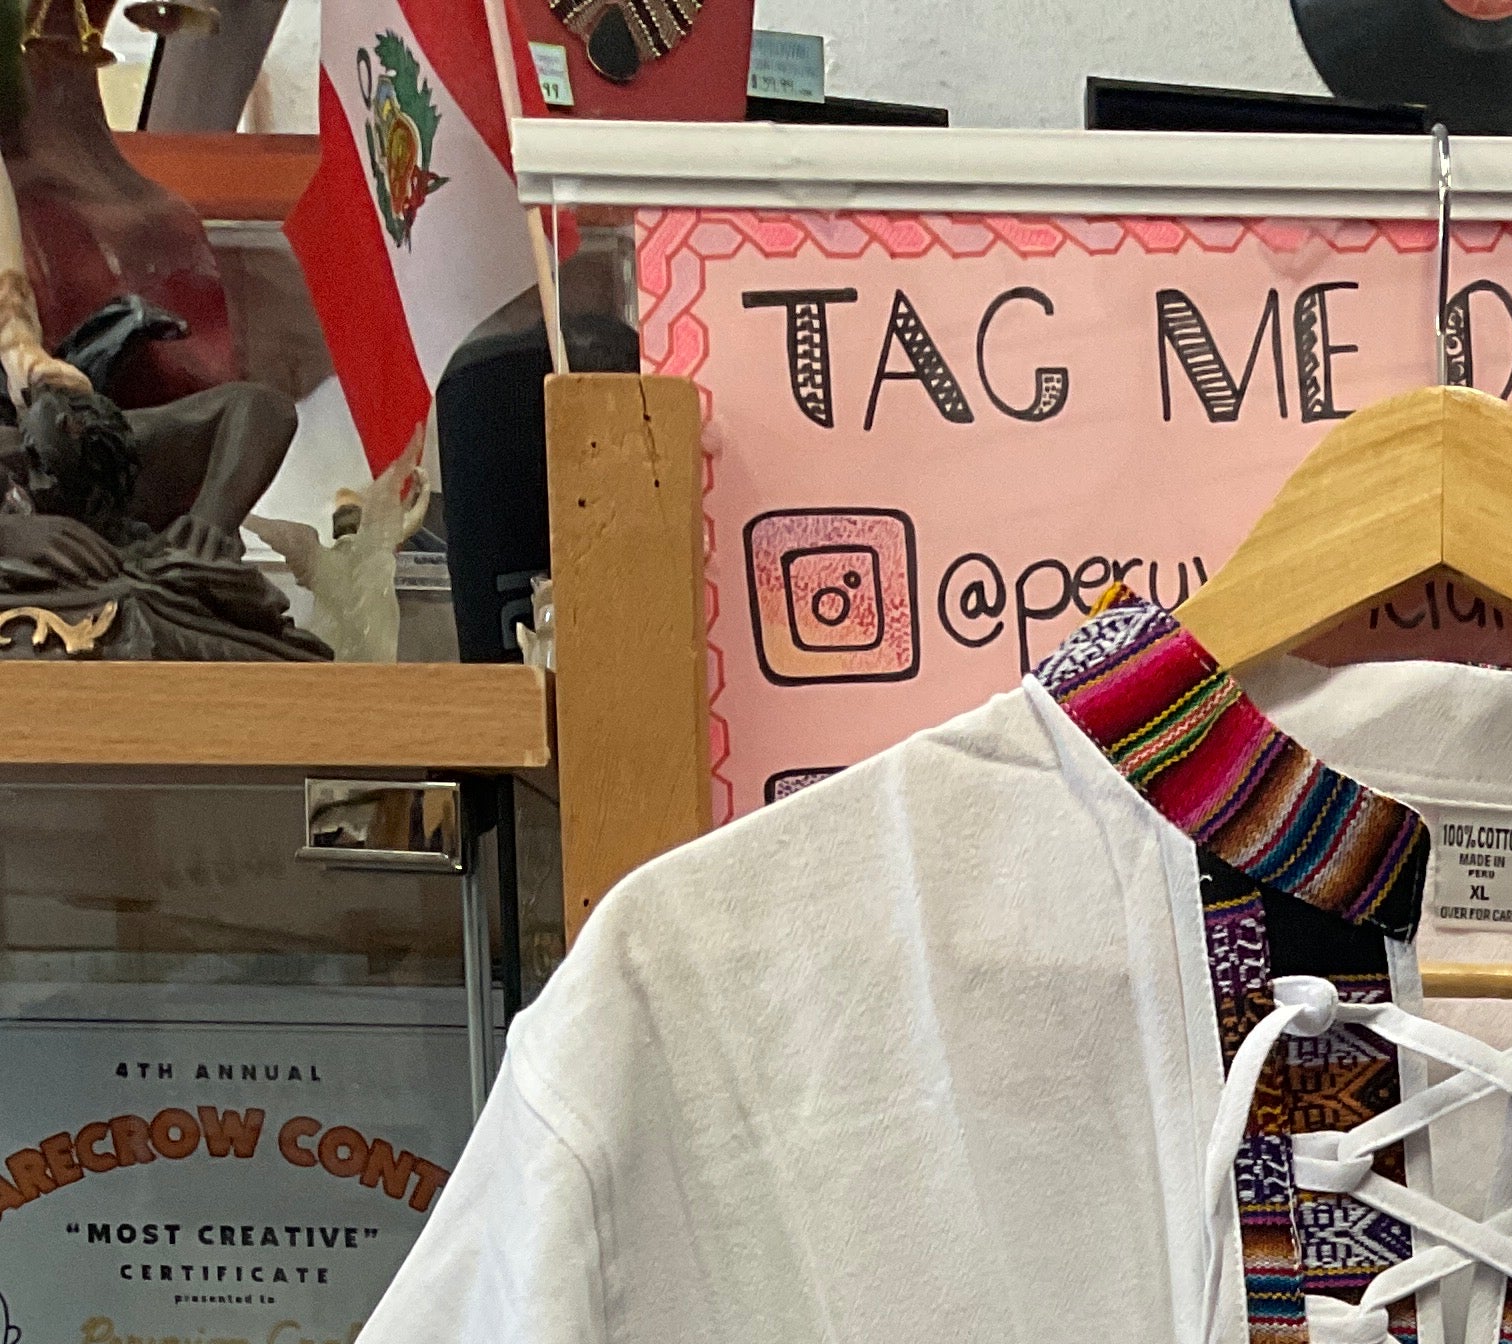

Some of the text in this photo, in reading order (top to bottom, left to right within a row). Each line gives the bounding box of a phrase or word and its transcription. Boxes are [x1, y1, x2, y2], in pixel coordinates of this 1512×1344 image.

[741, 285, 1069, 431] TAG
[1155, 281, 1359, 423] ME
[1442, 823, 1477, 849] 100%
[1458, 852, 1506, 868] MADE IN
[1467, 869, 1495, 879] PERU
[1469, 884, 1490, 901] XL
[1439, 906, 1470, 922] OVER
[1470, 908, 1492, 923] FOR
[115, 1061, 322, 1082] 4TH ANNUAL
[119, 1264, 329, 1284] CERTIFICATE
[174, 1294, 253, 1305] presented
